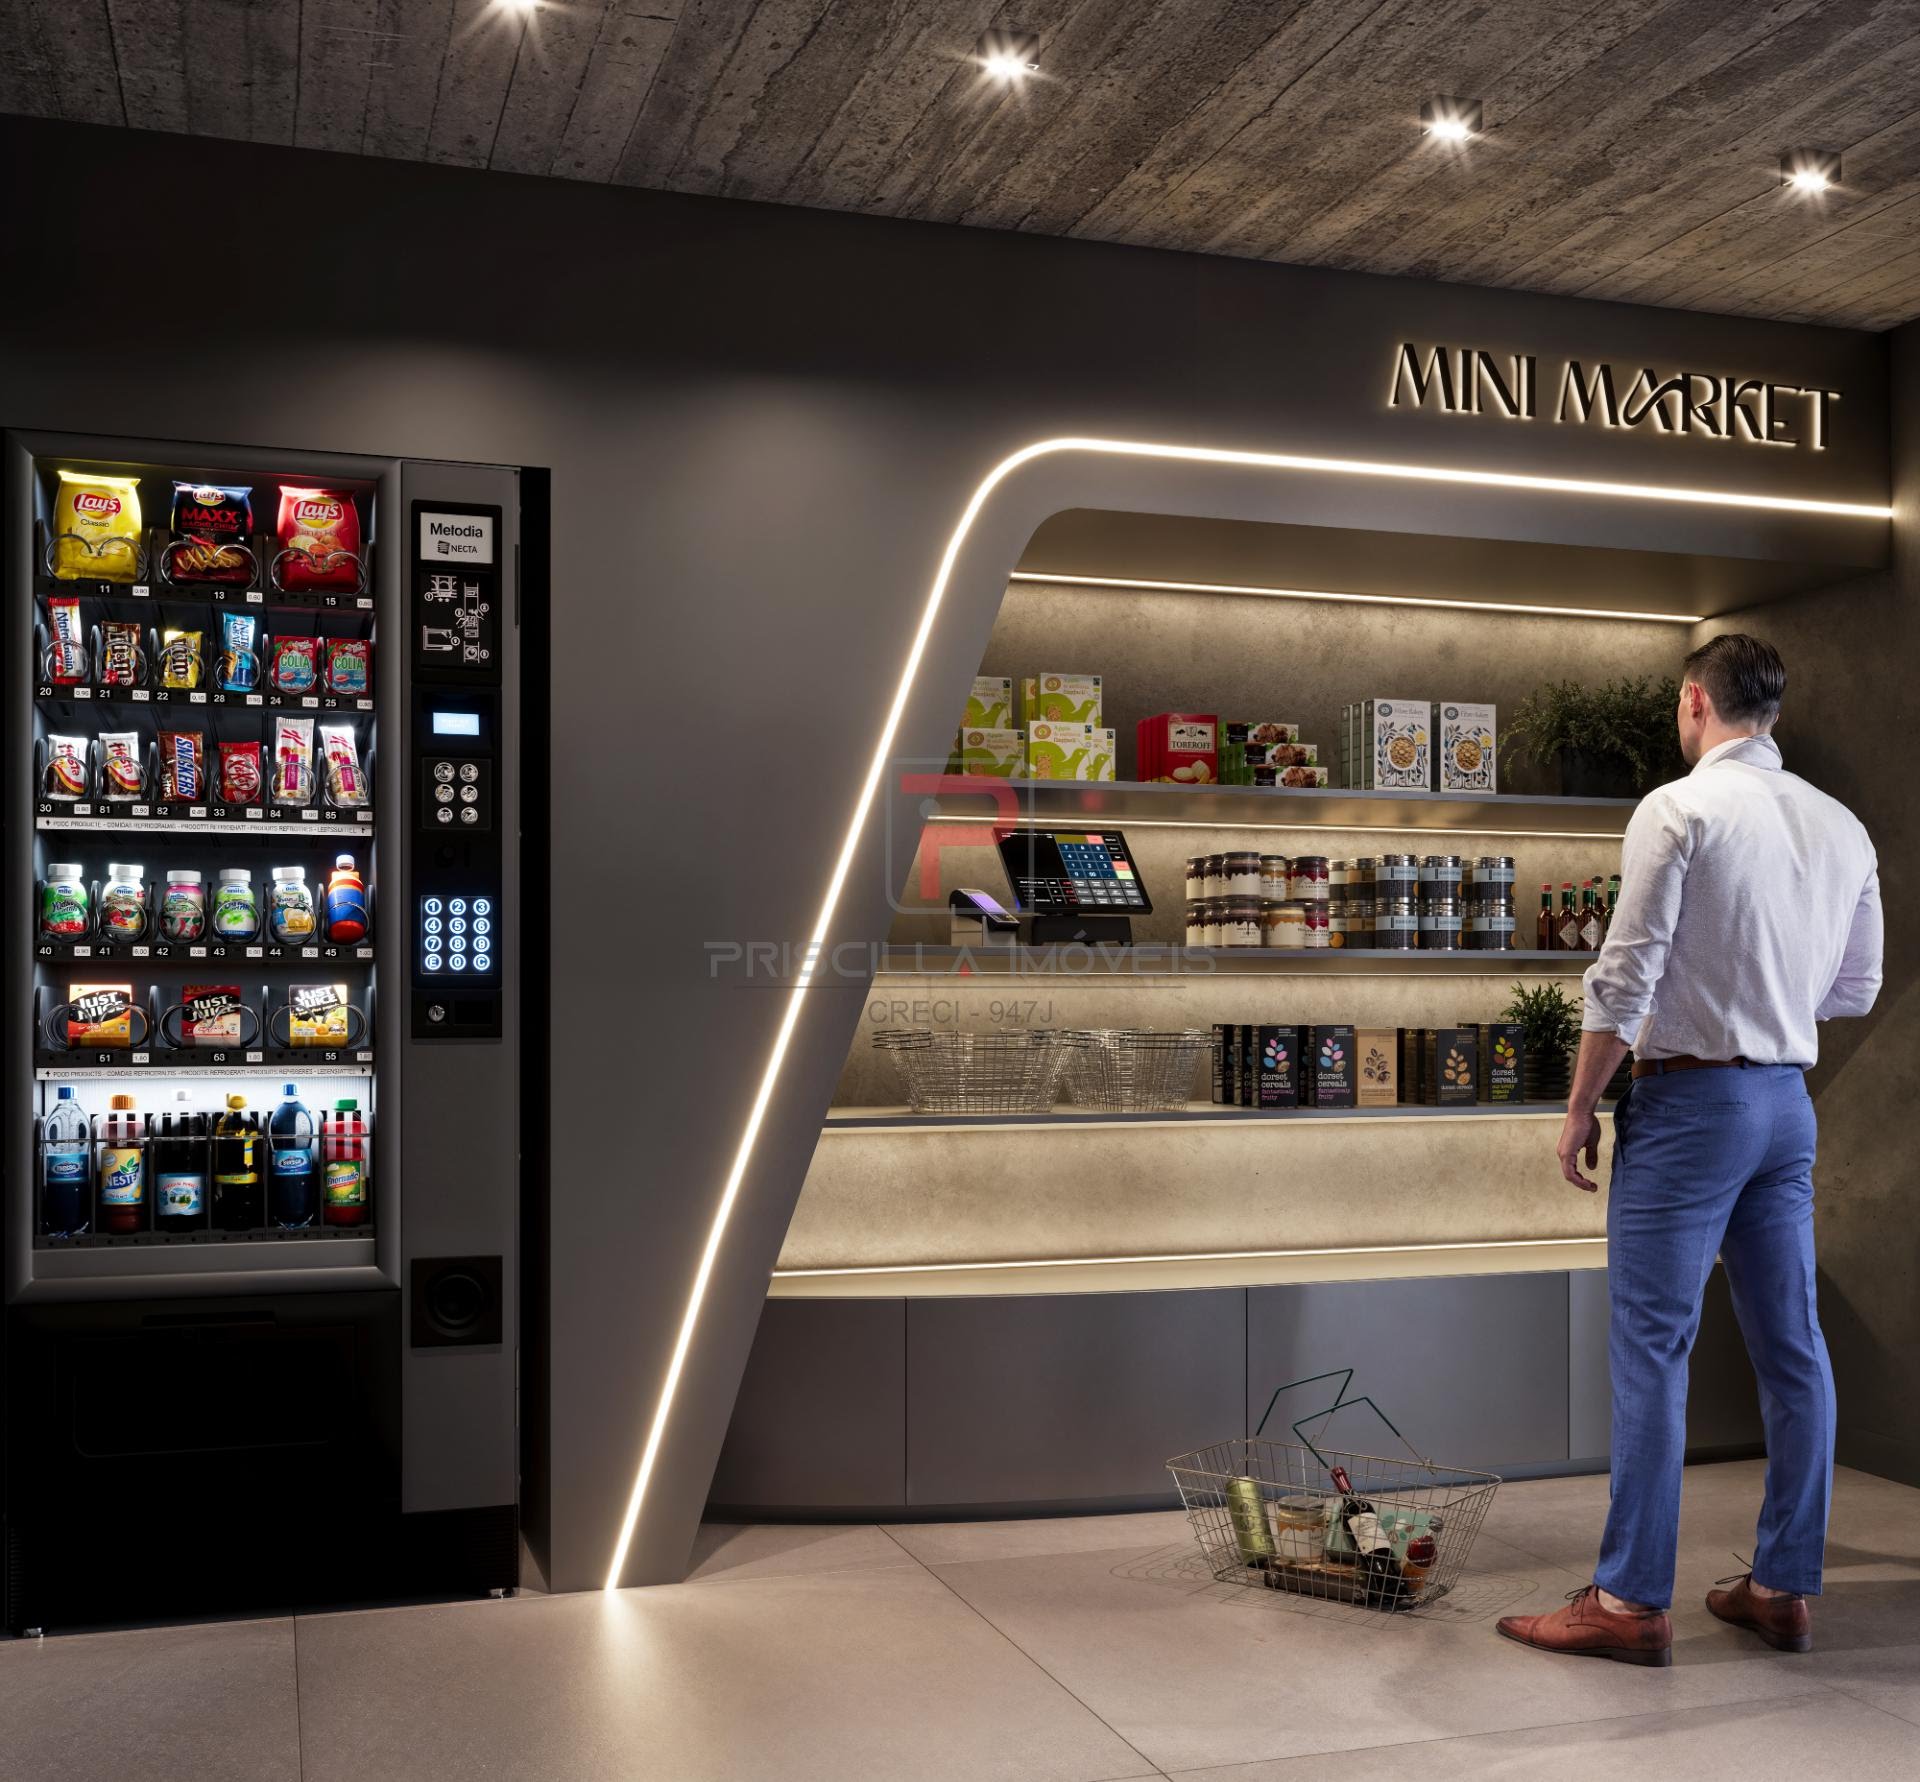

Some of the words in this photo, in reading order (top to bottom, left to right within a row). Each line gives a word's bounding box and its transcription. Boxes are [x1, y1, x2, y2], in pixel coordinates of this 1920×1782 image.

[1389, 343, 1537, 418] MINI
[1557, 361, 1845, 450] MARKET
[182, 507, 241, 524] MAXX
[430, 522, 483, 538] Melodia
[450, 544, 478, 554] NECTA
[100, 584, 110, 593] 11
[214, 591, 225, 600] 13
[325, 597, 337, 606] 15
[39, 686, 52, 696] 20
[99, 689, 111, 698] 21
[156, 691, 169, 701] 22
[270, 696, 282, 705] 24
[325, 698, 337, 707] 25
[39, 803, 52, 813] 30
[213, 808, 226, 817] 33
[39, 946, 52, 955] 40
[98, 947, 110, 956] 41
[156, 947, 169, 956] 42
[213, 947, 226, 956] 43
[269, 948, 282, 956] 44
[324, 948, 337, 957] 45
[325, 1052, 337, 1061] 55
[1261, 1072, 1288, 1081] dorset
[1317, 1071, 1344, 1080] dorset
[1261, 1080, 1291, 1089] cereals
[1317, 1079, 1347, 1088] cereals
[106, 1172, 139, 1188] NESTE
